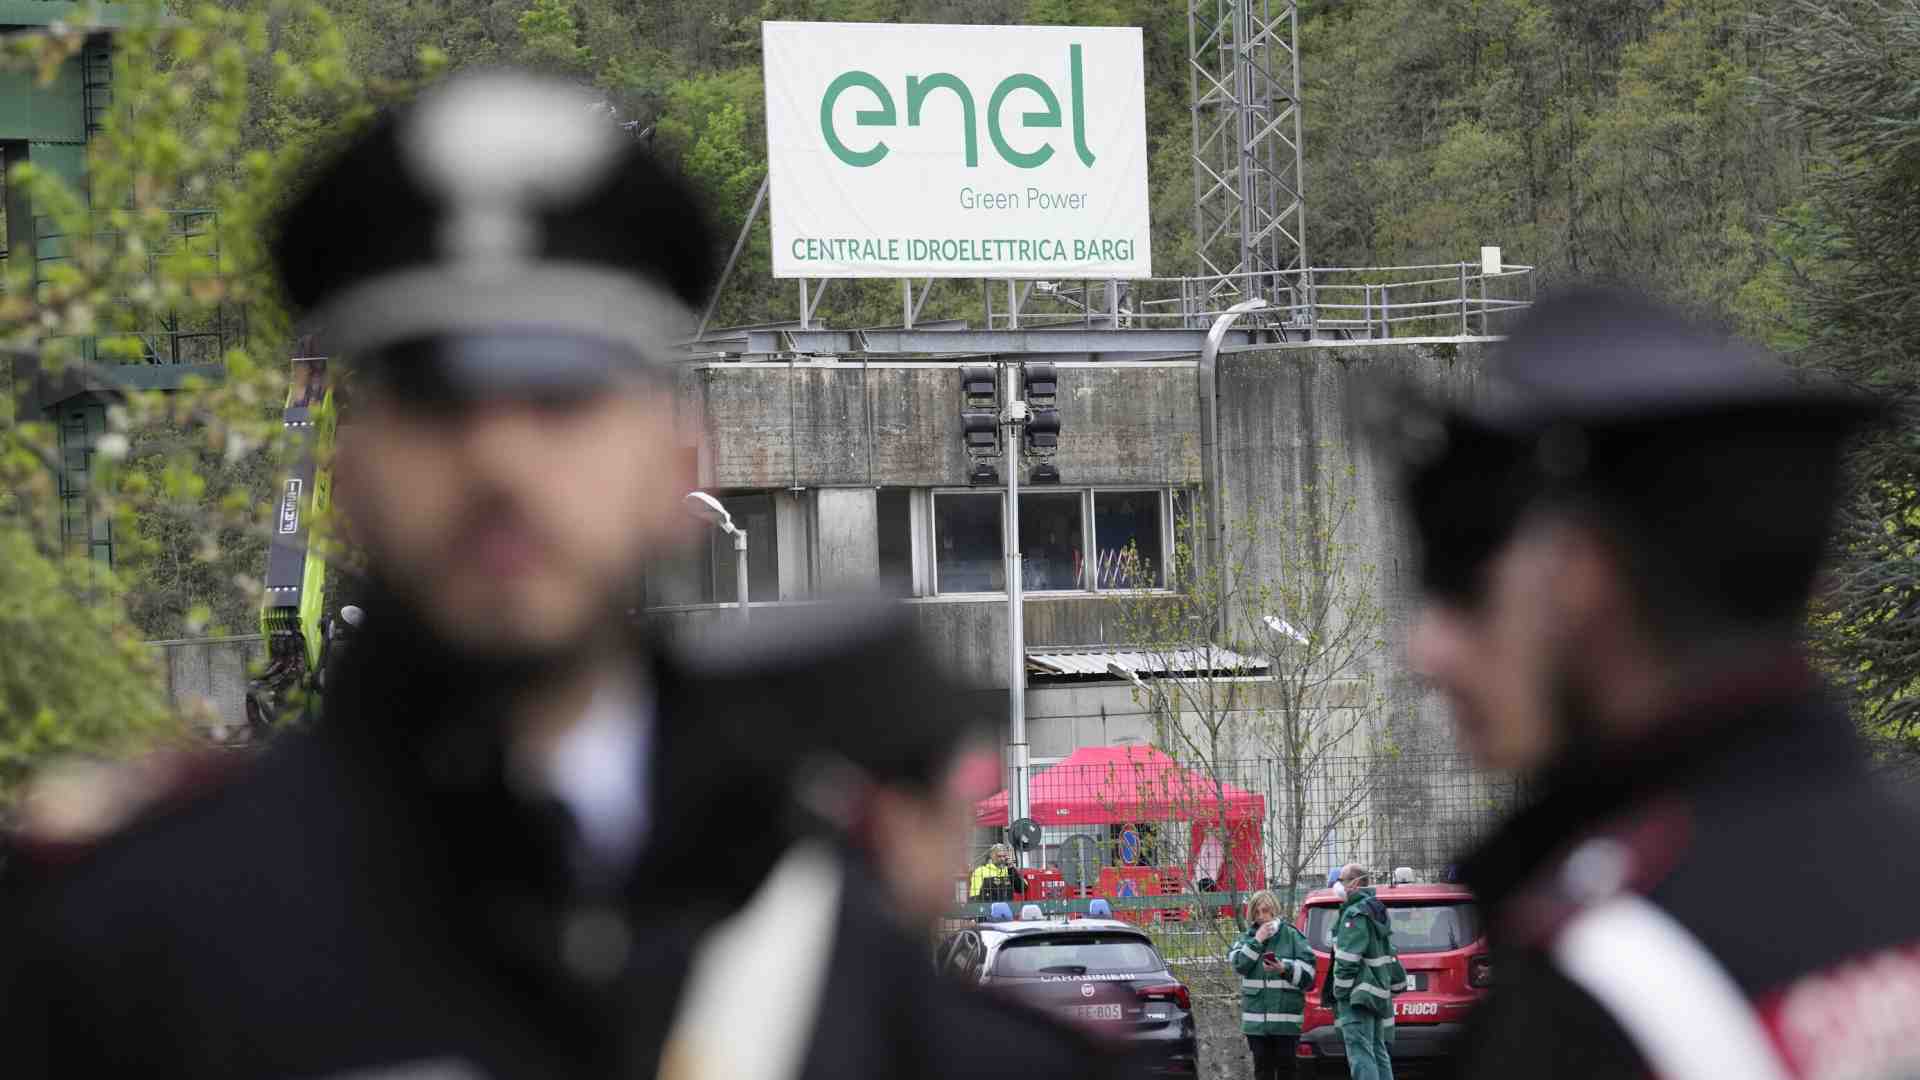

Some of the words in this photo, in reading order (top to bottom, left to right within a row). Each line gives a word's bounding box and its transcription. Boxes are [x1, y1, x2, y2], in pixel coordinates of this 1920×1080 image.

[820, 44, 1096, 169] enel
[960, 187, 1019, 210] Green
[1026, 188, 1088, 210] Power
[791, 238, 900, 261] CENTRALE
[906, 239, 1066, 261] IDROELETTRICA
[1074, 239, 1135, 261] BARGI
[1402, 1002, 1438, 1015] FUOCO
